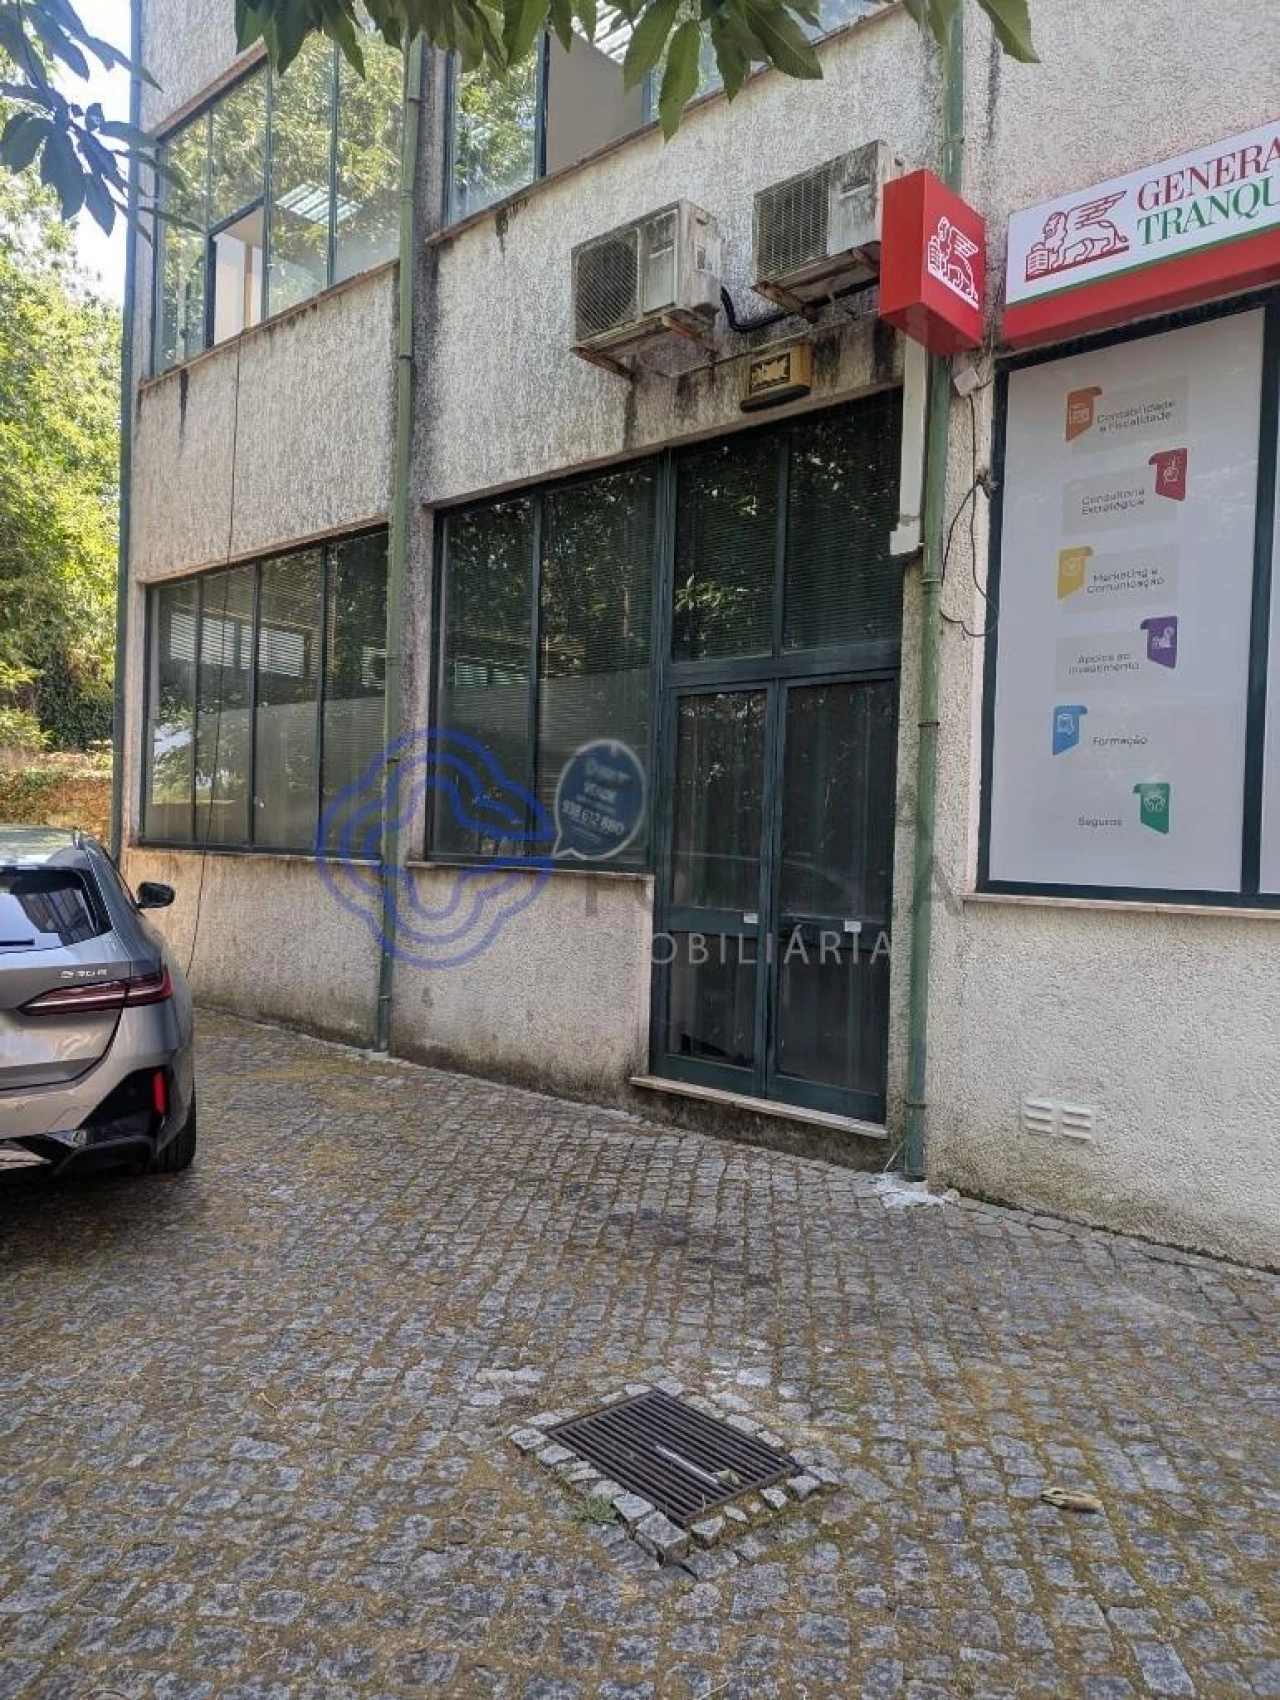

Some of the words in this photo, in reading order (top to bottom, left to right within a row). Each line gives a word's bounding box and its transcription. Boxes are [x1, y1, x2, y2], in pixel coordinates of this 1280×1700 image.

[1096, 399, 1175, 424] Contabilidade
[1108, 411, 1172, 432] Fiscalidade
[1081, 488, 1145, 506] Consultoria
[1093, 568, 1148, 583] Marketing
[1086, 576, 1165, 594] Comunicação
[1093, 734, 1148, 746] Formação
[1078, 817, 1123, 828] Seguros
